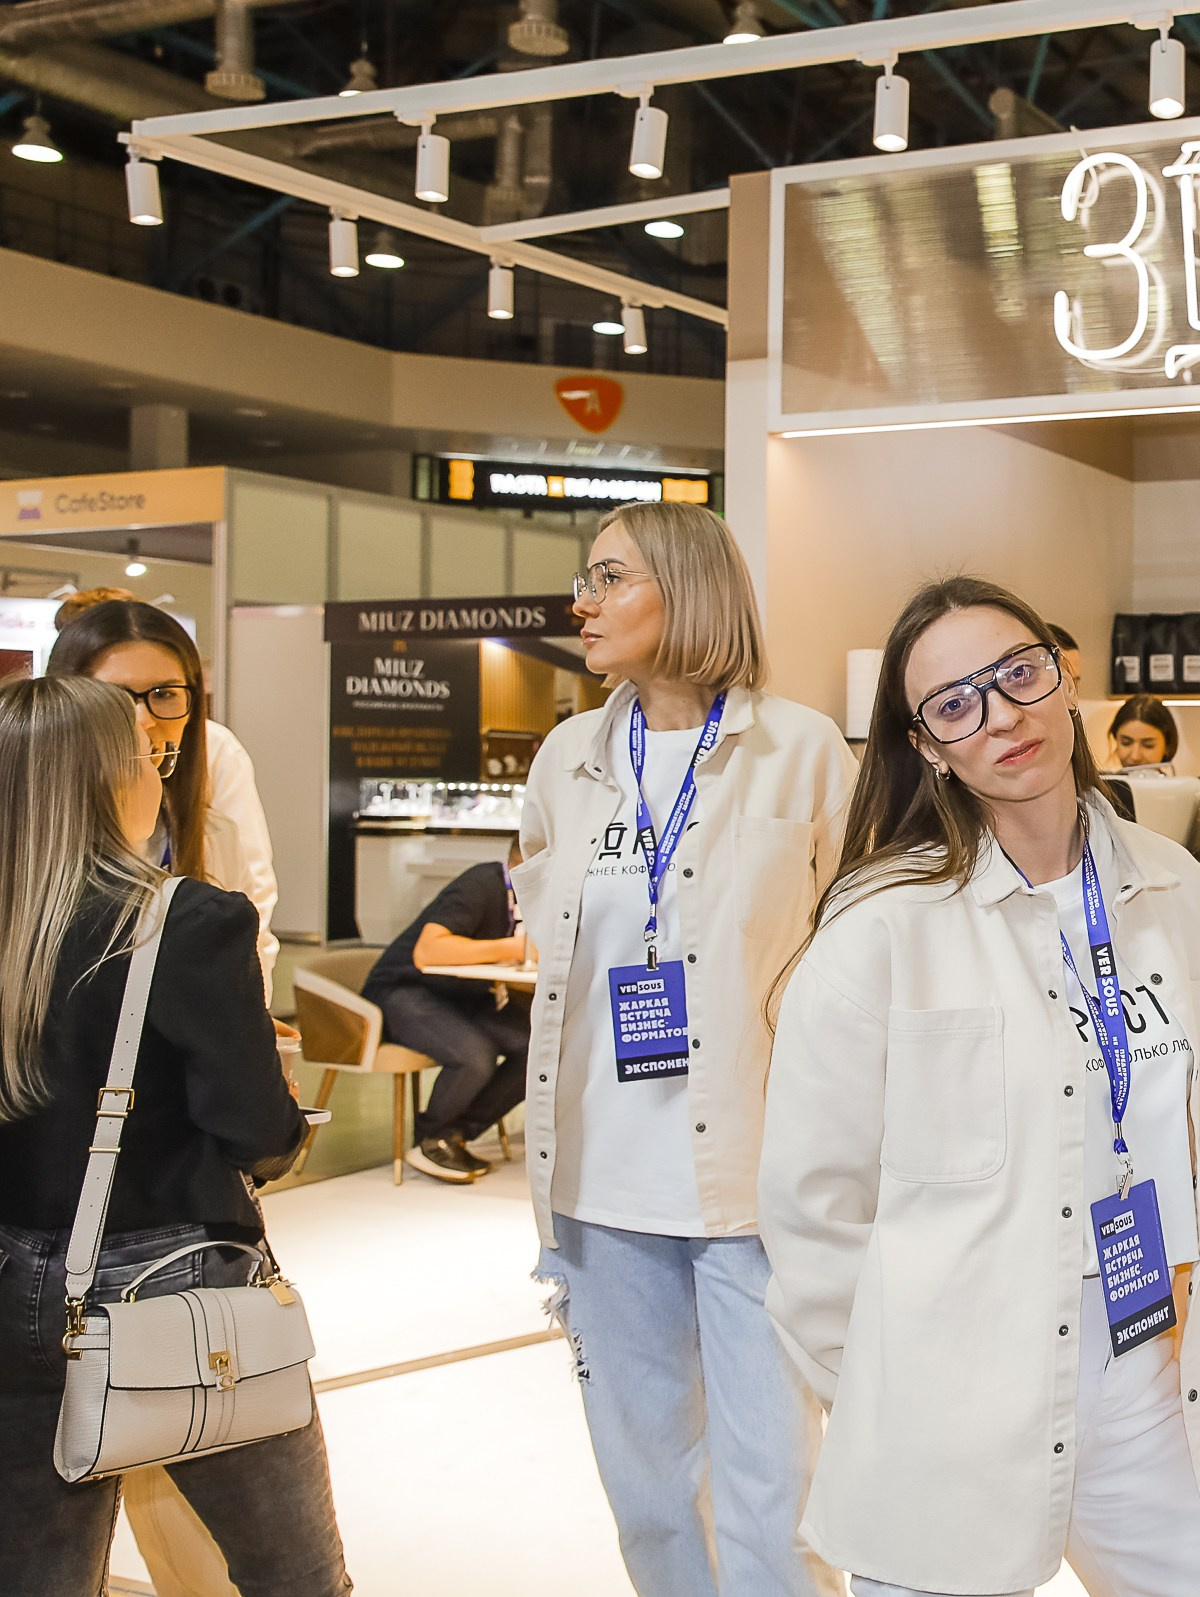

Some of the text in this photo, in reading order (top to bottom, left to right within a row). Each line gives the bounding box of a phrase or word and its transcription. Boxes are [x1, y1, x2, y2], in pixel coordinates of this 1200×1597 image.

[358, 606, 546, 633] MIUZ DIAMONDS
[373, 657, 425, 679] MIUZ
[345, 675, 451, 699] DIAMONDS
[586, 865, 618, 878] ЖНЕЕ
[619, 997, 669, 1012] ЖАРКАЯ
[619, 1007, 672, 1022] ВСТРЕЧА
[620, 1019, 669, 1033] БИЗНЕС-
[624, 1057, 690, 1075] ЭКСПОНЕН
[1103, 1234, 1141, 1261] ЖАРКАЯ
[1105, 1247, 1144, 1275] ВСТРЕЧА
[1107, 1263, 1143, 1289] БИЗНЕС-
[1109, 1269, 1160, 1302] ФОРМАТОВ
[1116, 1305, 1170, 1345] ЭКСПОНЕНТ
